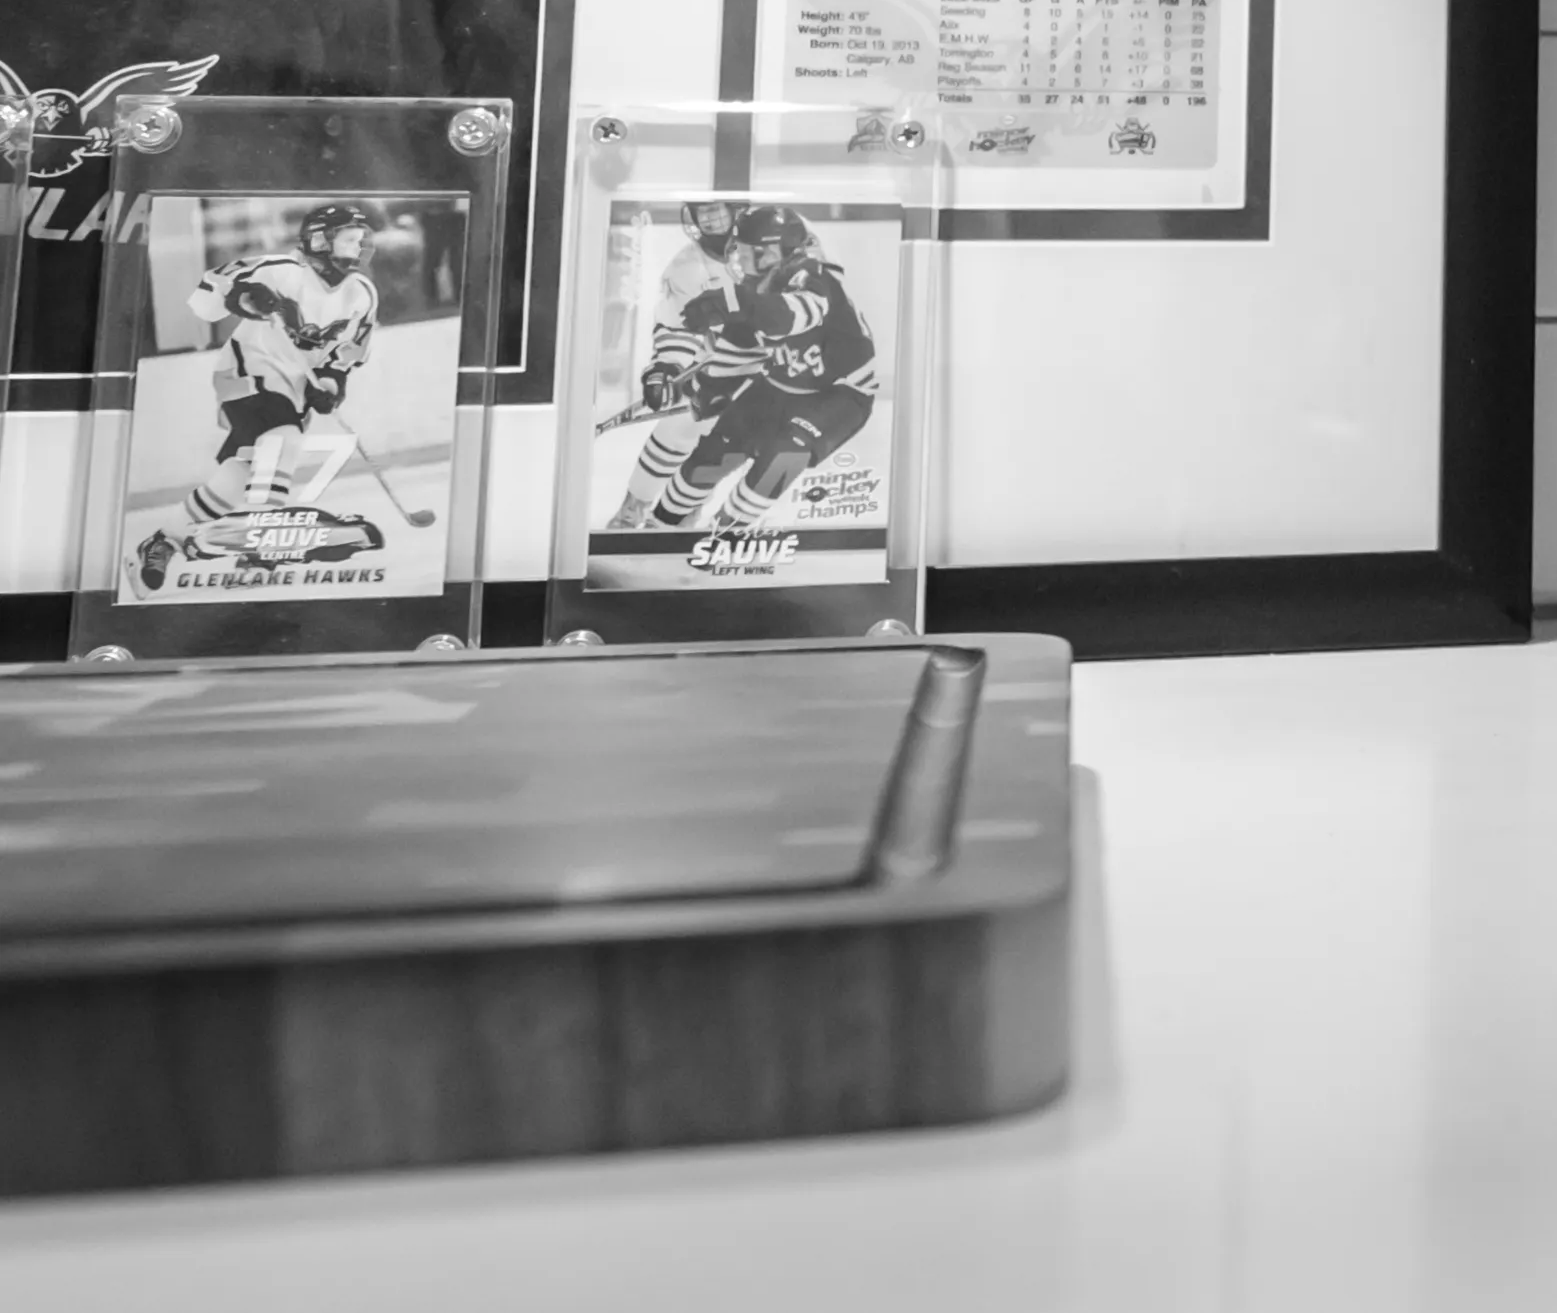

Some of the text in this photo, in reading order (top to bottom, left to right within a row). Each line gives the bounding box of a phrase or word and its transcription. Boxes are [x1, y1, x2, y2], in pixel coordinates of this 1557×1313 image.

[801, 11, 844, 23] Height:
[798, 25, 844, 37] Weight:
[810, 39, 844, 49] Born:
[847, 40, 868, 50] Oct
[795, 67, 868, 77] Shoots: Left
[938, 93, 973, 103] Totals
[1045, 94, 1059, 104] 27
[236, 433, 359, 504] 17
[803, 467, 873, 487] minor
[797, 497, 878, 520] champs
[245, 510, 319, 528] KESLER
[244, 527, 331, 548] SAUVE
[690, 533, 800, 567] SAUVÉ
[176, 568, 386, 588] GLENLAKE HAWKS
[711, 565, 775, 576] LEFT WING
